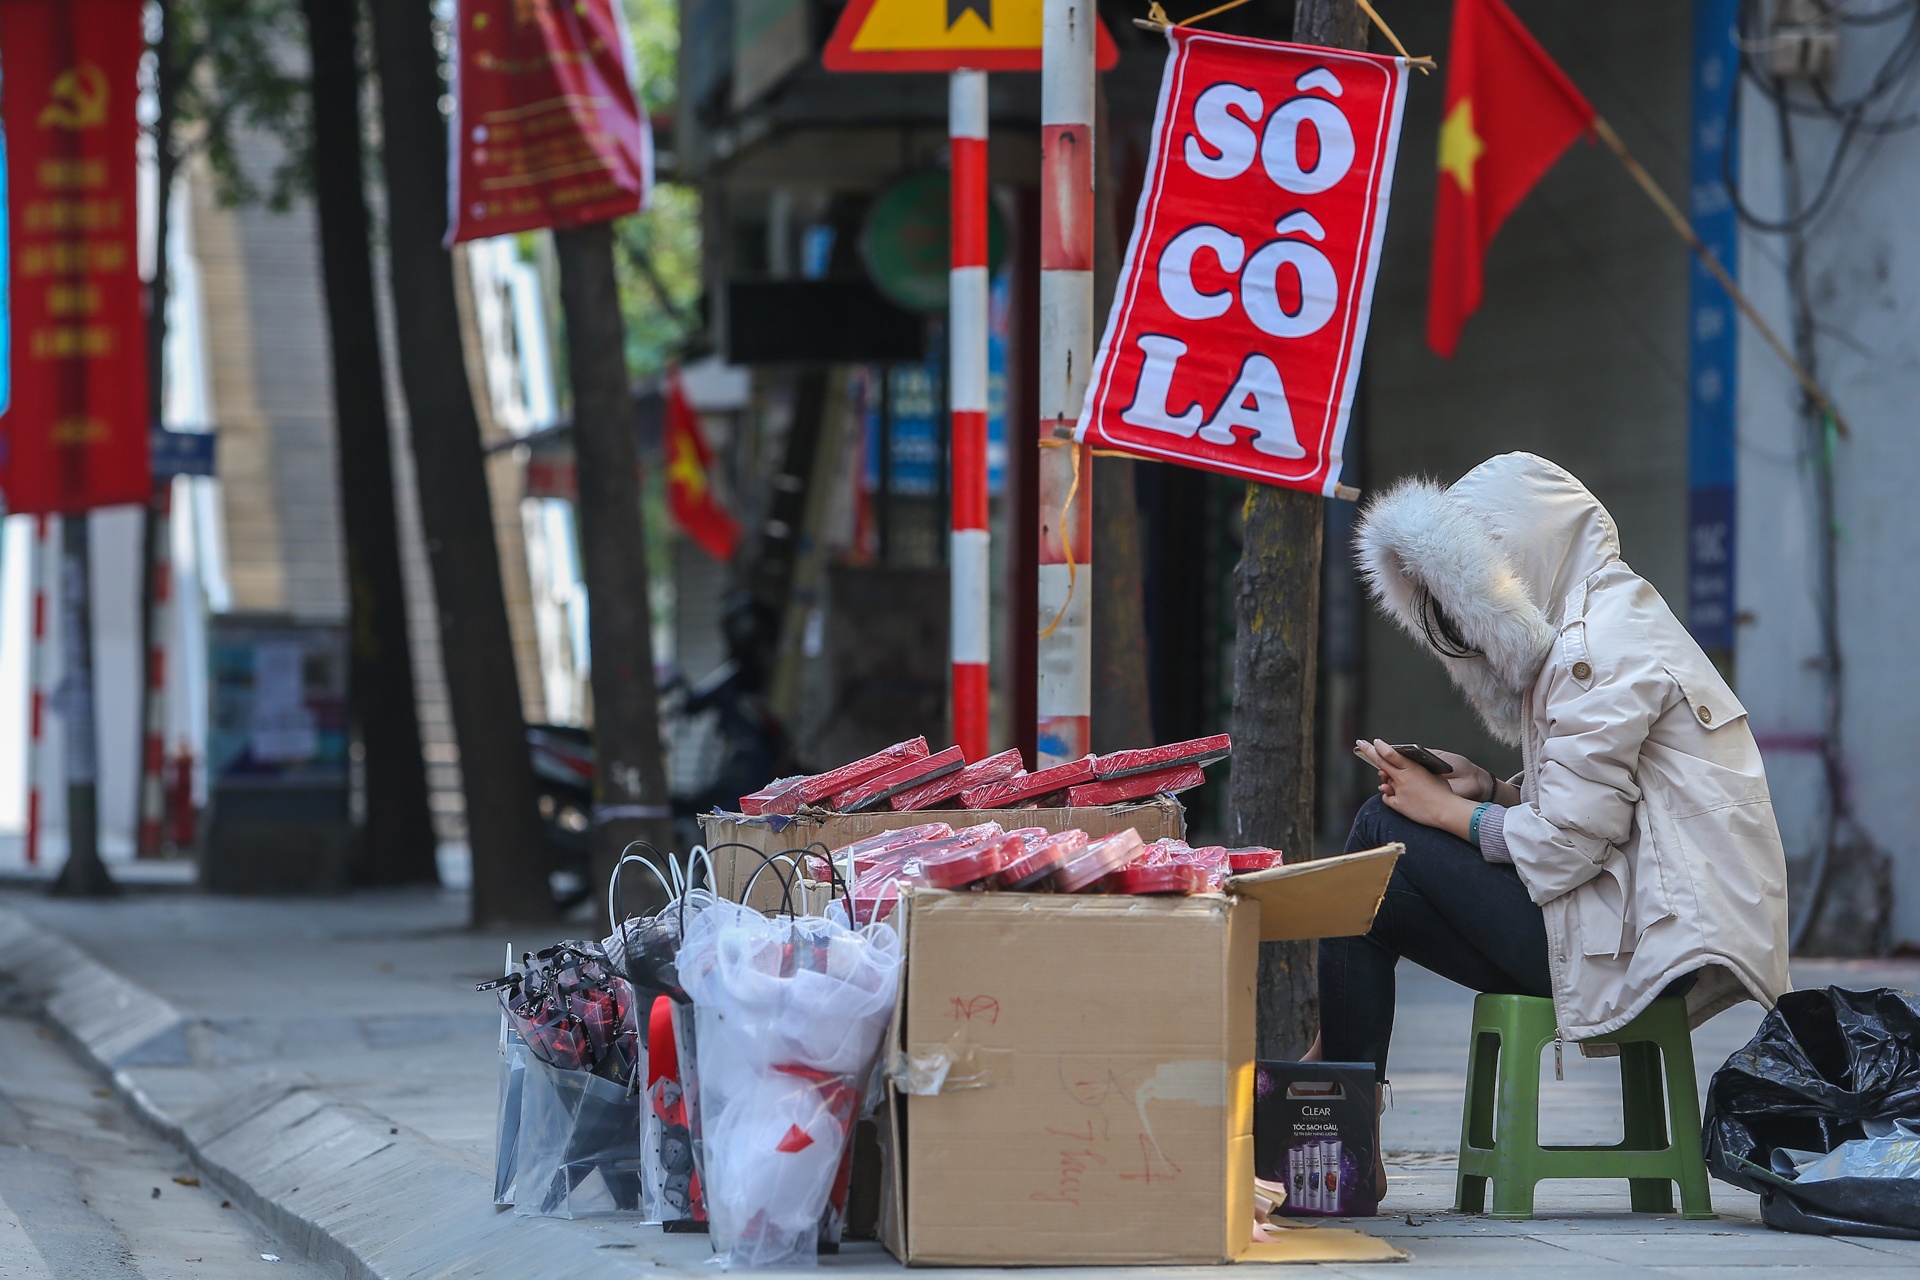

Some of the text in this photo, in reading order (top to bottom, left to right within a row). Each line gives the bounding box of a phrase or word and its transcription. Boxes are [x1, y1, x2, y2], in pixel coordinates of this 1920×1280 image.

[1184, 66, 1356, 195] SÔ
[1158, 208, 1339, 338] CÔ
[1121, 333, 1306, 459] LA
[1293, 1122, 1305, 1131] TÓC
[1306, 1123, 1322, 1132] SẠCH
